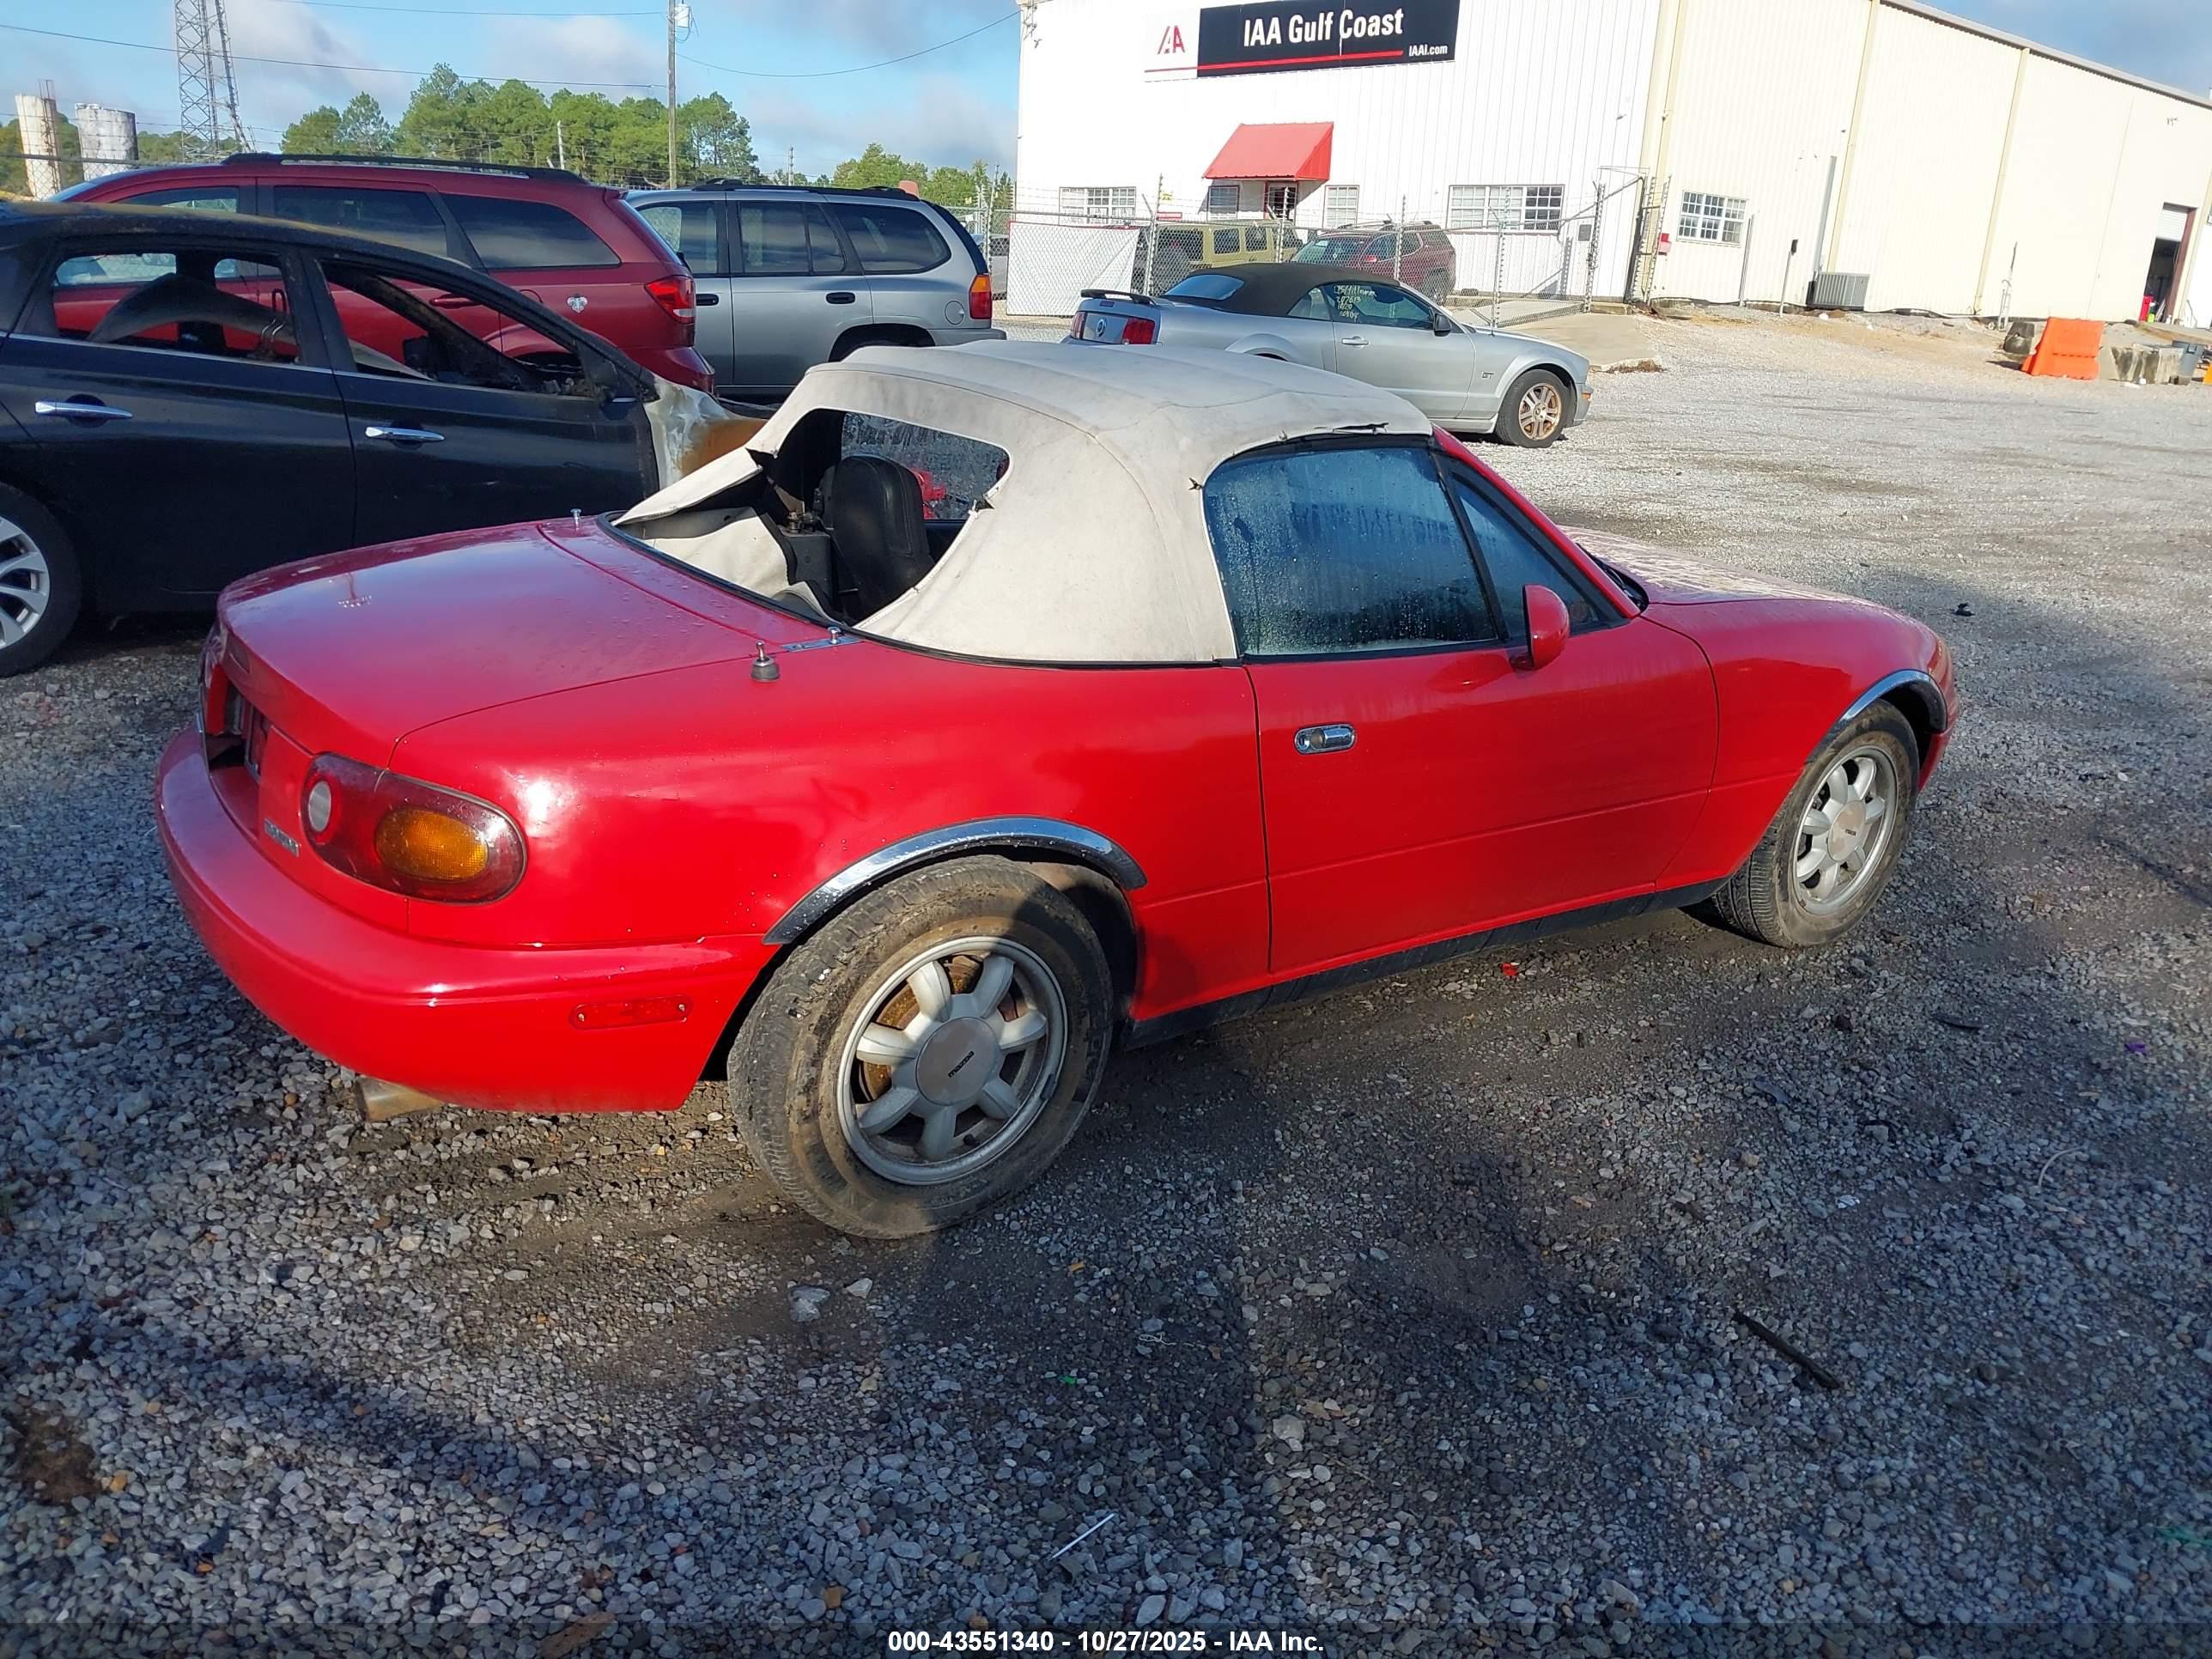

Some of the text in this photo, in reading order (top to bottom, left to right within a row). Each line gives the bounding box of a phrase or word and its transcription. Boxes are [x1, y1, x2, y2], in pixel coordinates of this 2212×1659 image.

[1243, 8, 1404, 46] IAA Gulf Coast
[1408, 44, 1449, 57] IAAI.com
